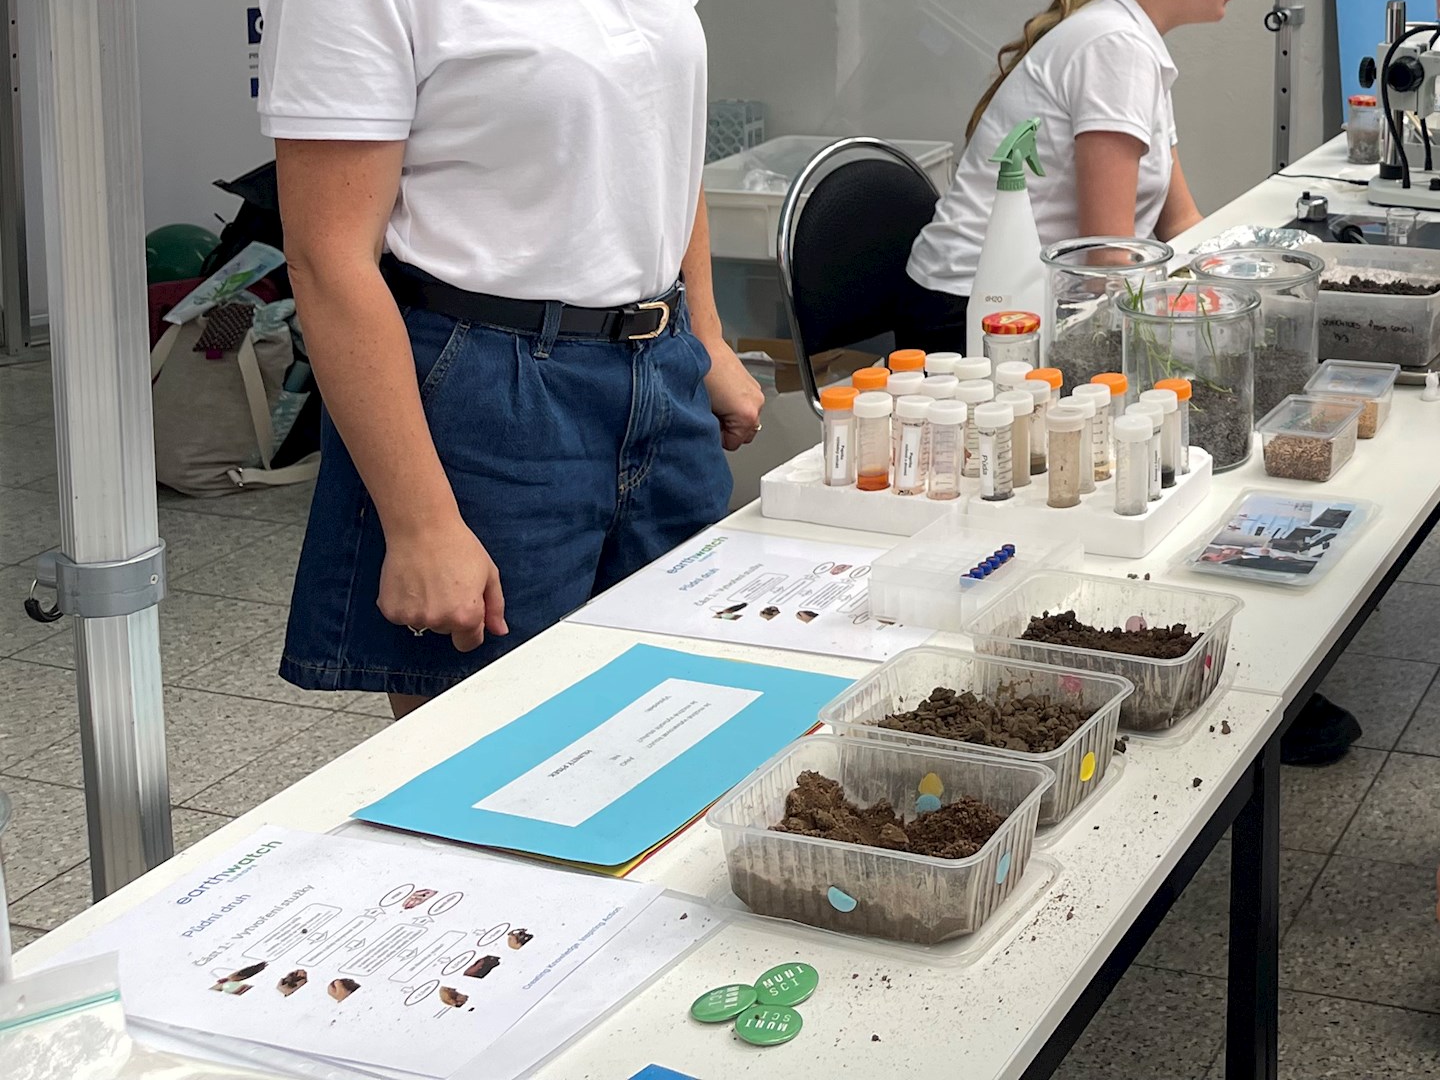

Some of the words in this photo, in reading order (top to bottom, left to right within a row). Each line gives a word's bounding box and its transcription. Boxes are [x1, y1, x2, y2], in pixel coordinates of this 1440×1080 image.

[667, 536, 728, 574] earthwatch
[177, 840, 283, 905] earthwatch
[182, 913, 222, 938] Půdní
[221, 893, 251, 913] druh
[231, 905, 284, 940] Vytvoření
[762, 966, 804, 989] MUNI
[769, 978, 800, 996] SCI
[745, 1019, 789, 1032] MUNI
[760, 1011, 791, 1022] SCI
